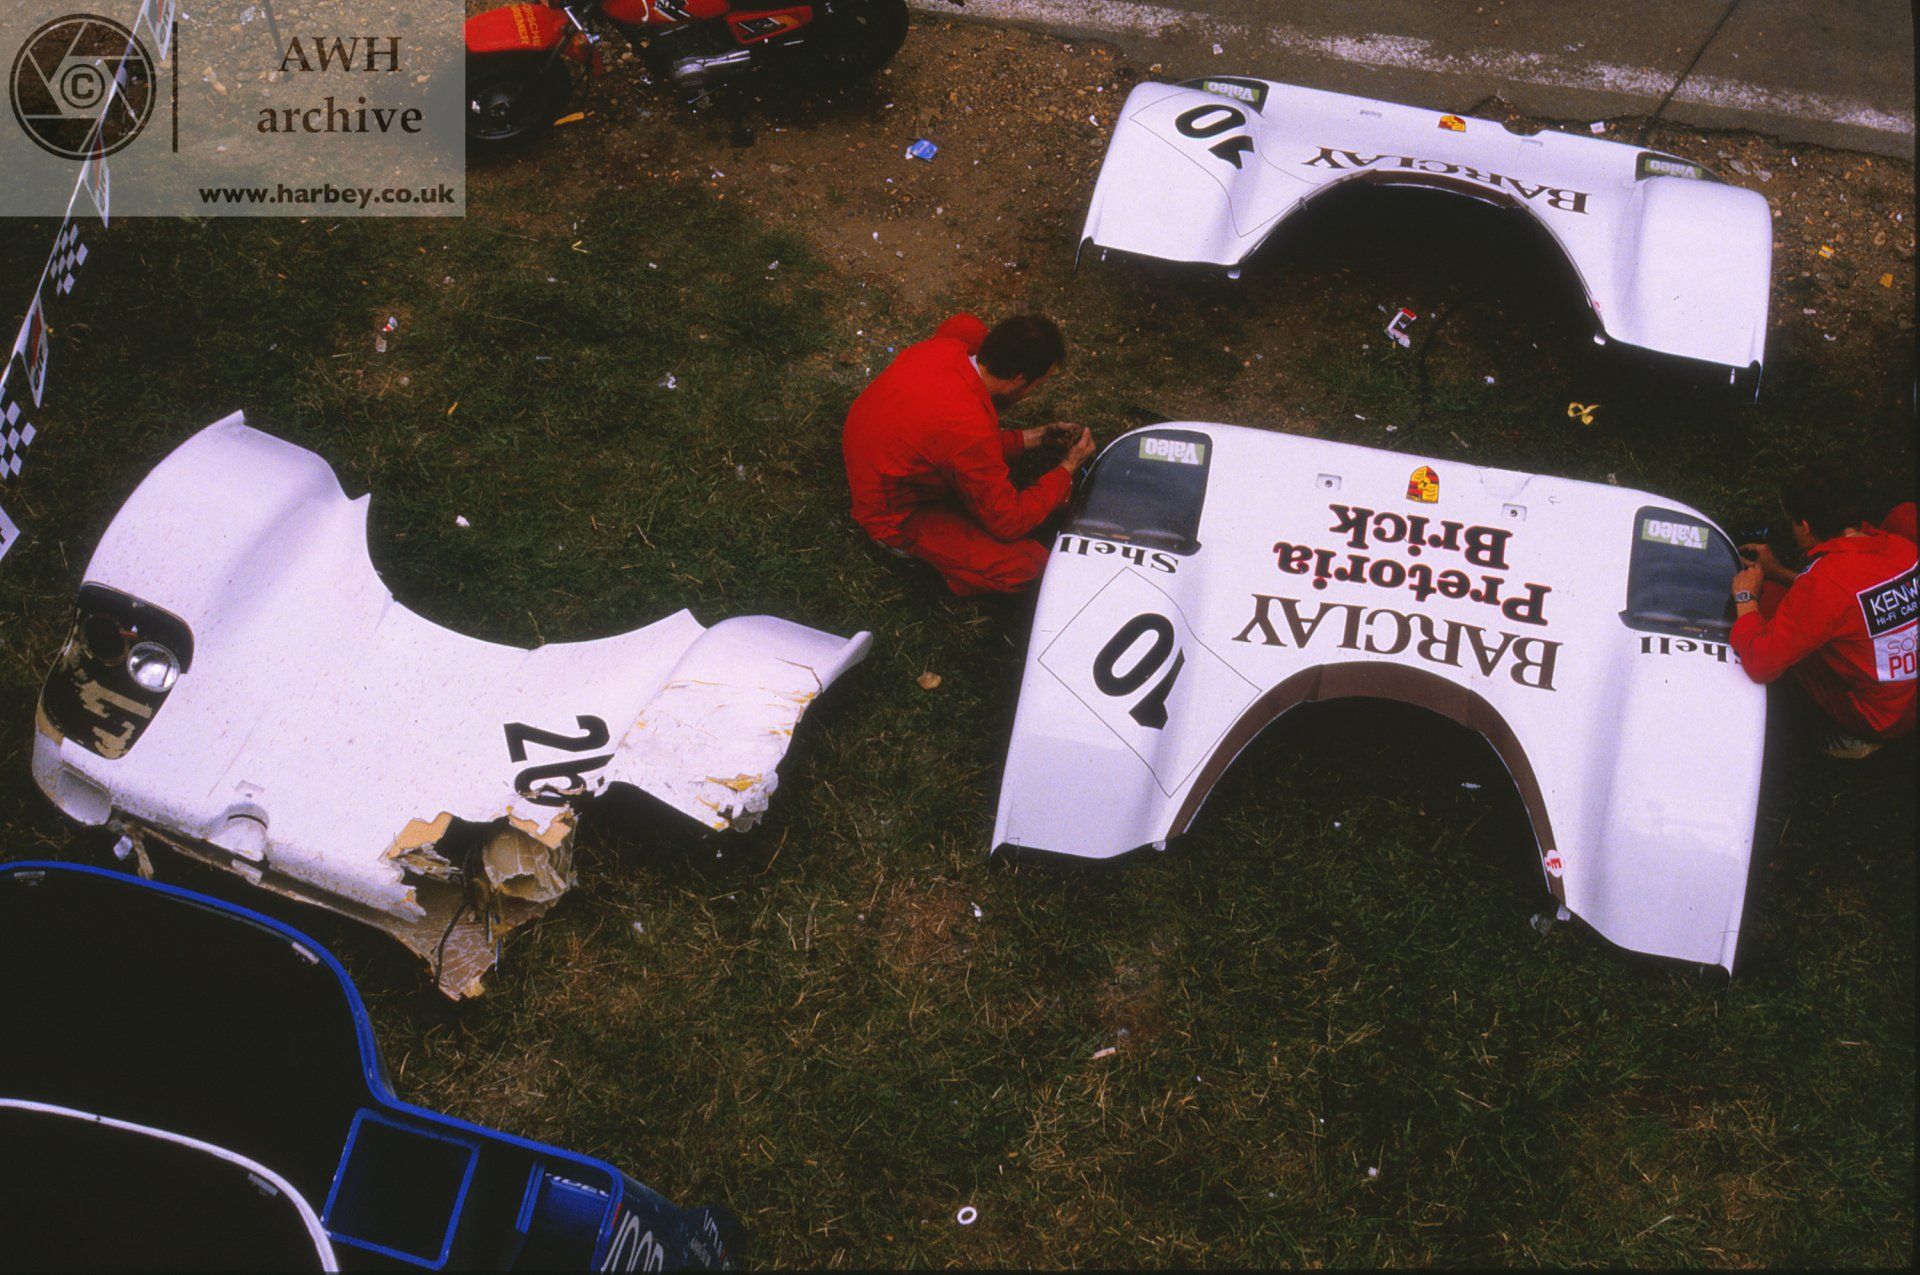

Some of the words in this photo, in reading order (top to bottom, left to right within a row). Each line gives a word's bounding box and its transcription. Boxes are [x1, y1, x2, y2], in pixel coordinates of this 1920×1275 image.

[521, 3, 542, 47] ORSCHE
[1207, 81, 1255, 102] Valeo
[1175, 104, 1254, 169] 10
[1301, 146, 1591, 214] BARCLAY
[1145, 438, 1199, 465] Valeo
[1059, 537, 1179, 574] Shell
[1329, 504, 1513, 570] Brick
[1648, 520, 1703, 549] Valeo
[1273, 541, 1552, 626] Pretoria
[1870, 577, 1919, 616] KENW
[1231, 593, 1563, 691] BARCLAY
[1887, 634, 1918, 655] SO
[1093, 613, 1185, 730] 10
[503, 715, 615, 807] 26
